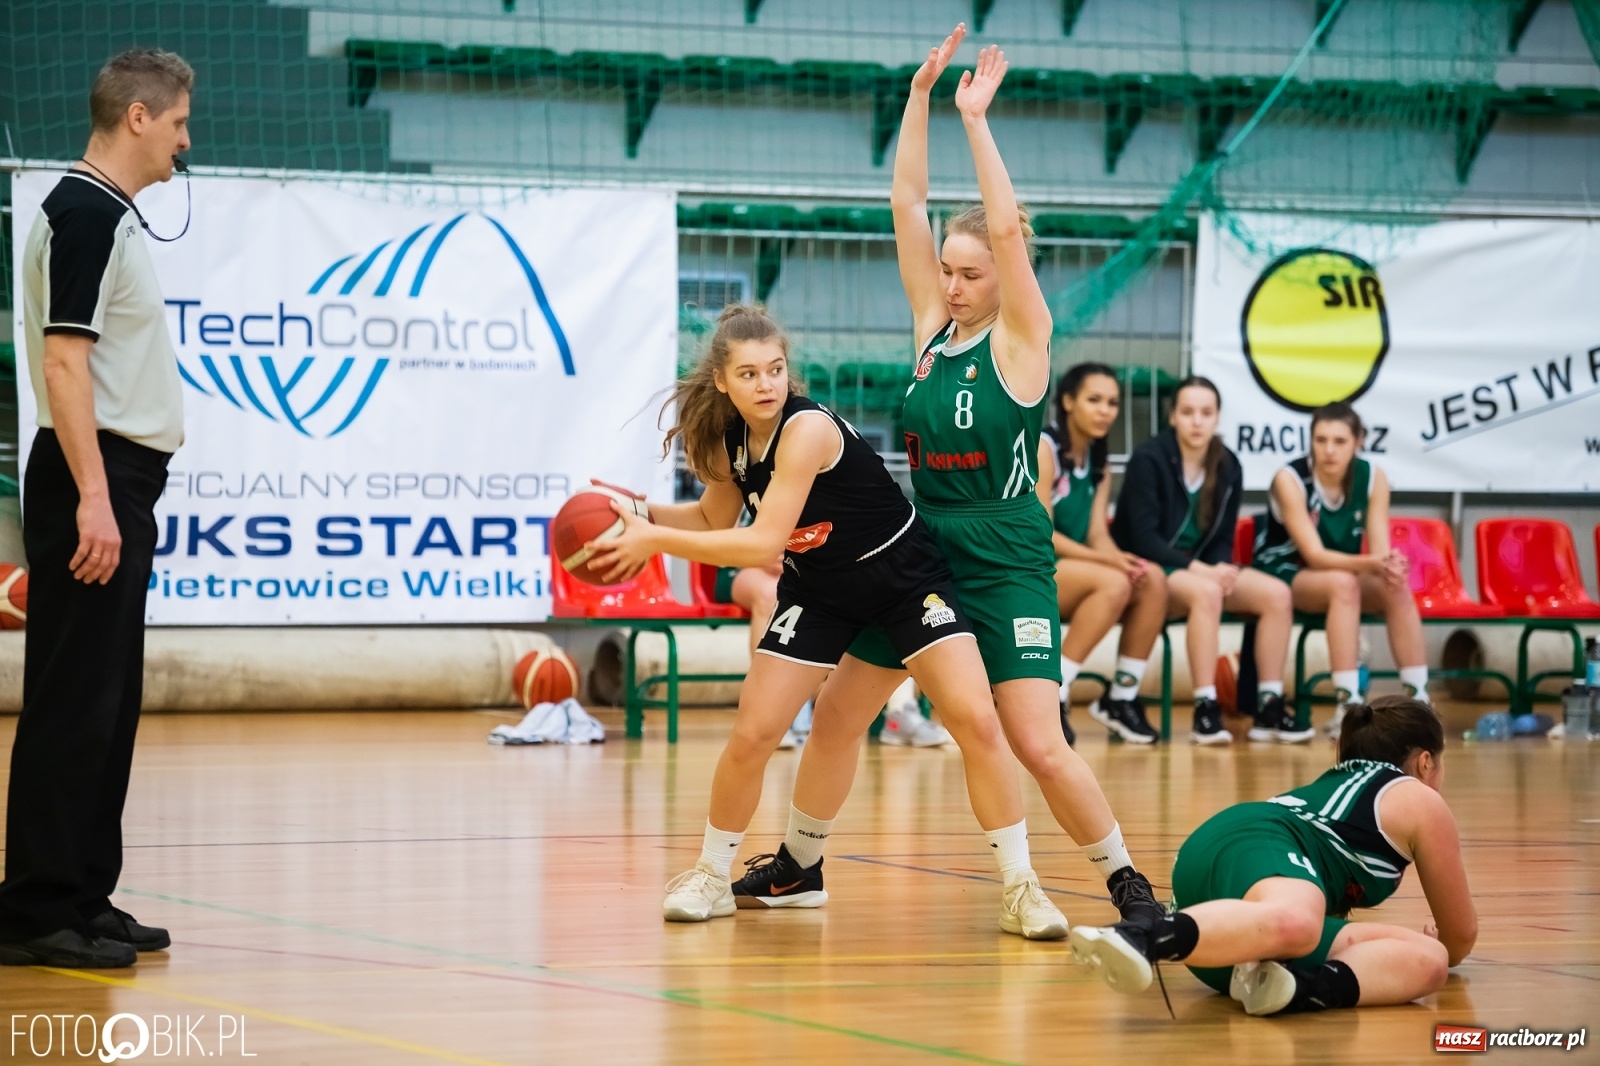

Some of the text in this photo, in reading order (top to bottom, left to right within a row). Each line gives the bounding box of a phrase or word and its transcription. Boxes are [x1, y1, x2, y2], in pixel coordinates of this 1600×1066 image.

[164, 299, 535, 351] TechControl
[399, 358, 536, 370] partner w badaniach
[954, 389, 974, 430] 8
[1421, 374, 1518, 441] JEST
[1532, 356, 1572, 400] W
[1237, 424, 1389, 454] RACIZ
[926, 451, 987, 470] KAMAN
[163, 471, 569, 500] FICJALNY SPONSOR
[316, 515, 552, 558] START
[402, 569, 554, 598] Wielki
